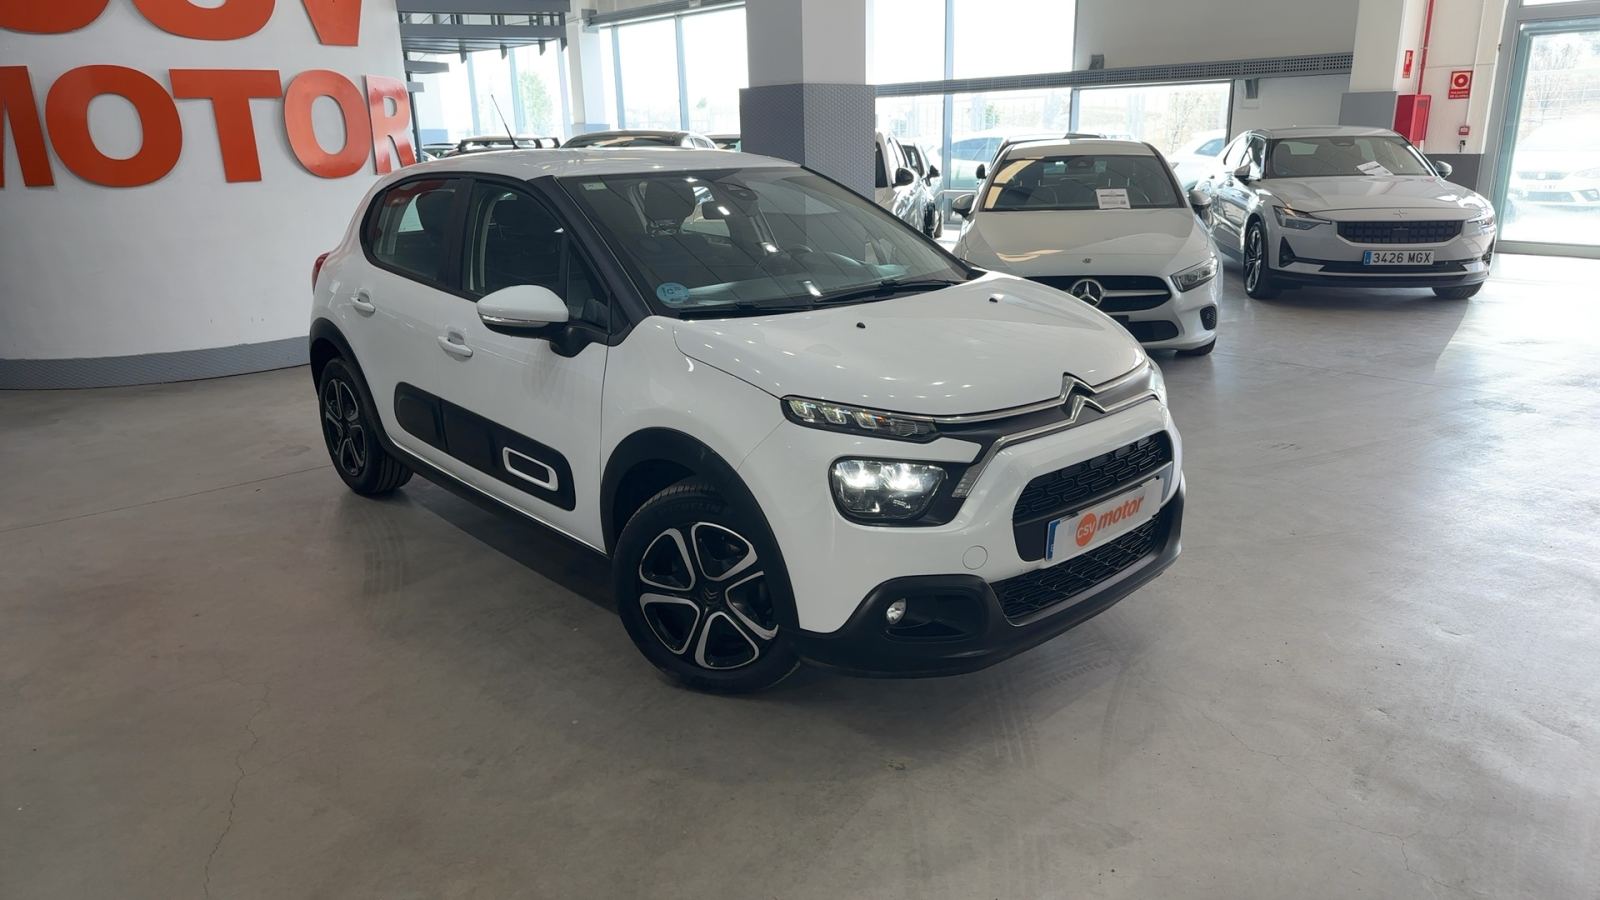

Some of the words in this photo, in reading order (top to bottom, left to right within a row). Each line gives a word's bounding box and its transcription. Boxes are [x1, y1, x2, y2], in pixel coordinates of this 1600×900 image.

[1373, 252, 1404, 264] 3426
[1408, 252, 1431, 263] MGX
[1097, 496, 1144, 531] motor
